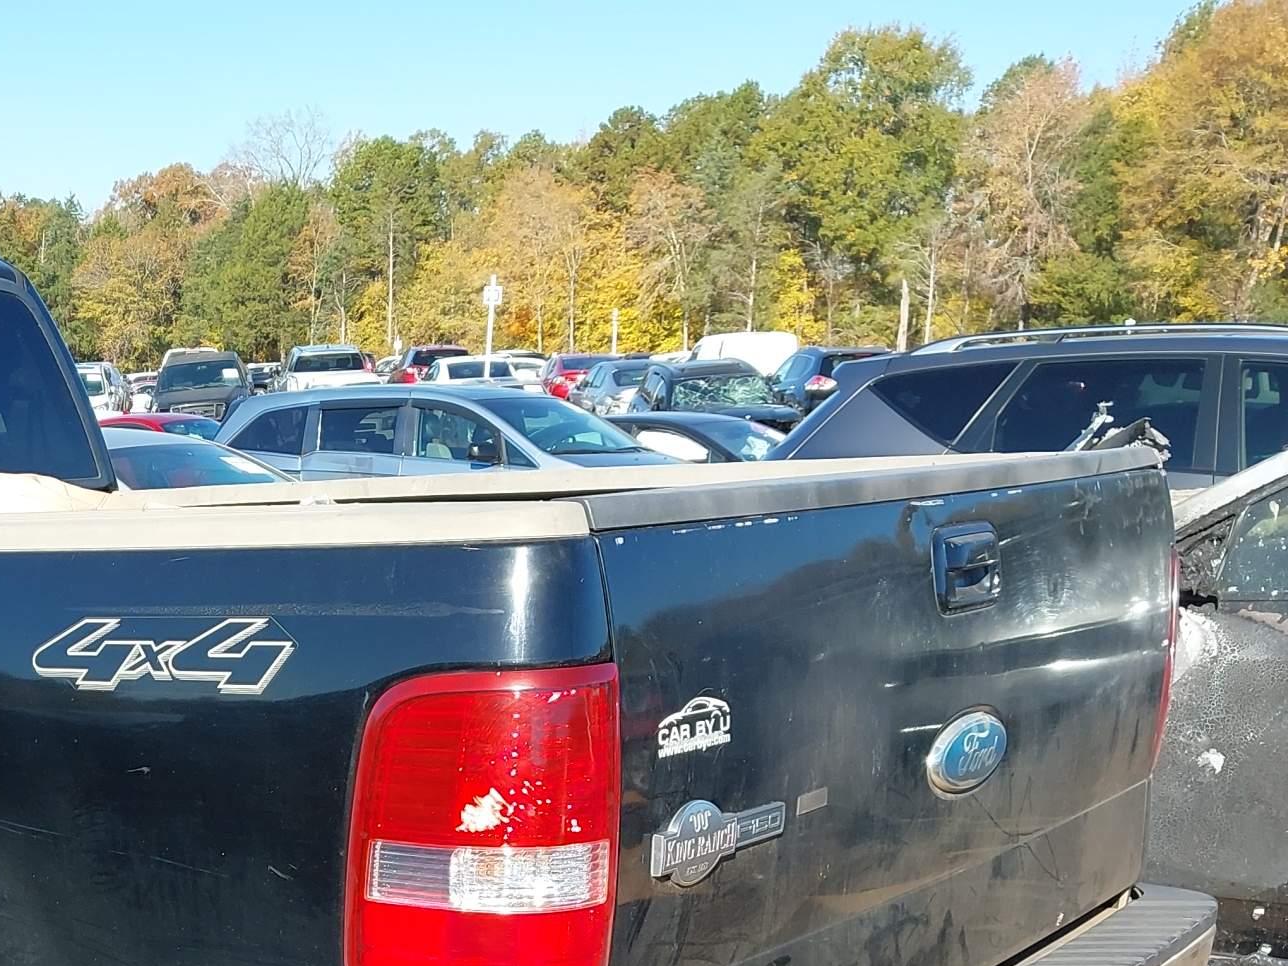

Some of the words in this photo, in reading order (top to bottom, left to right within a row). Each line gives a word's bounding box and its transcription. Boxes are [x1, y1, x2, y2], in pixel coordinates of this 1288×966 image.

[32, 617, 296, 695] 4x4
[658, 723, 691, 746] CAR
[696, 718, 715, 738] BY
[720, 714, 731, 732] U
[958, 728, 999, 777] Ford
[665, 838, 697, 868] KING
[696, 821, 737, 858] RANCH
